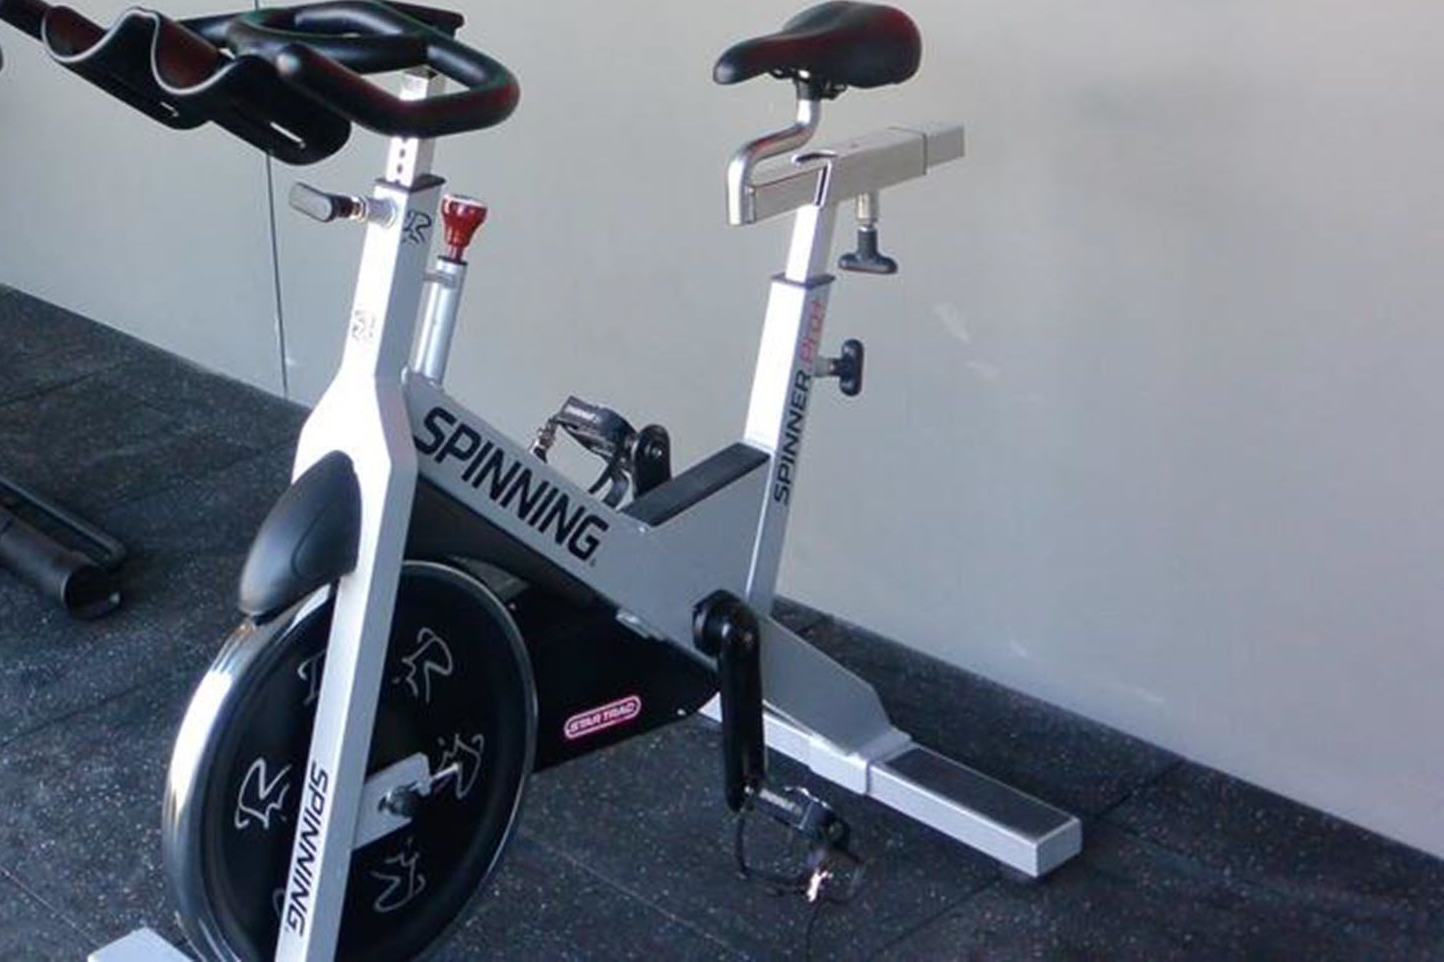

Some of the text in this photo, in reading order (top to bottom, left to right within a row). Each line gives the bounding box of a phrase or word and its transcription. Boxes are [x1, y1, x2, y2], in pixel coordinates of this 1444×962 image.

[412, 406, 610, 562] SPINNING
[773, 369, 811, 506] SPINNER
[286, 759, 329, 938] SPINNING
